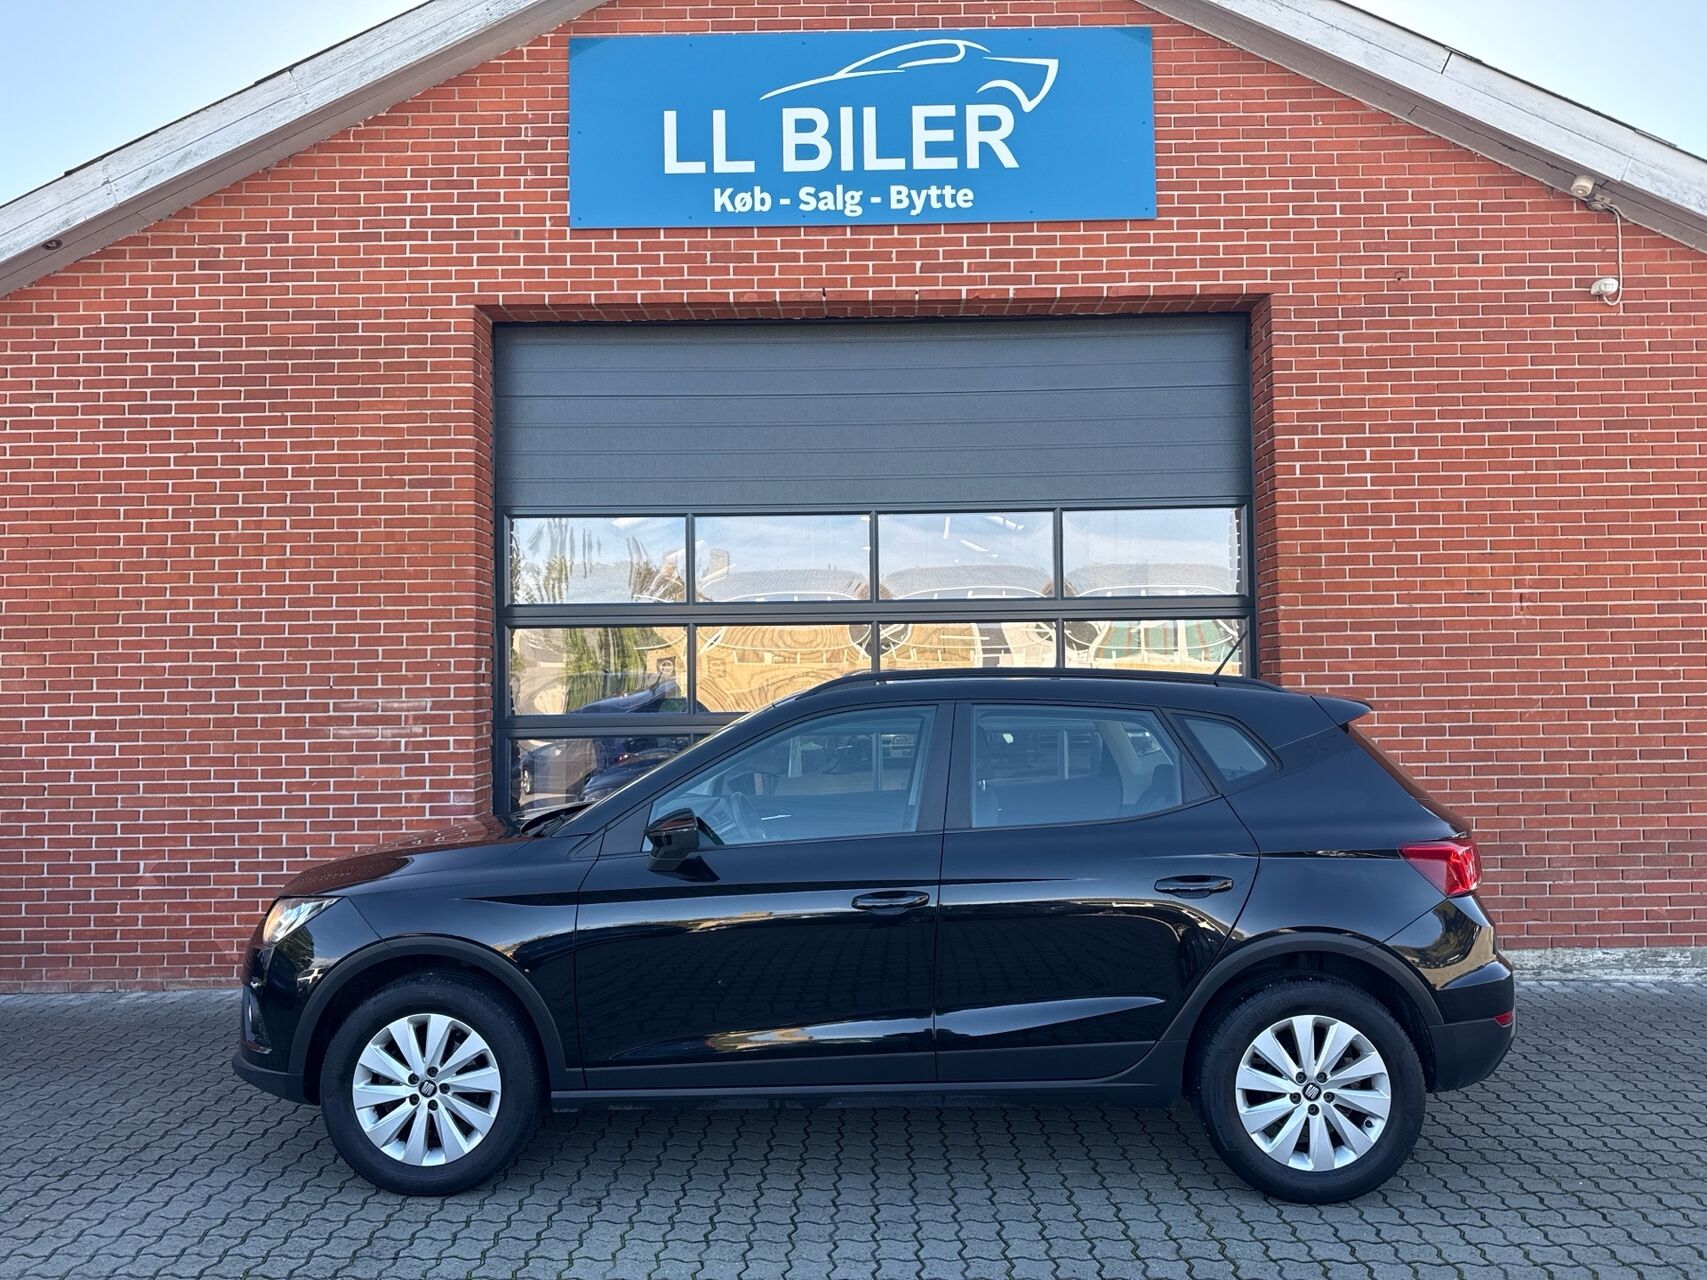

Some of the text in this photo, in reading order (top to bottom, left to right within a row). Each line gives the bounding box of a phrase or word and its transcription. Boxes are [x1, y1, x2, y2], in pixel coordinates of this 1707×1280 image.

[663, 104, 1019, 175] LL BILER
[713, 187, 772, 213] Køb
[798, 186, 863, 217] Salg
[889, 185, 974, 217] Bytte
